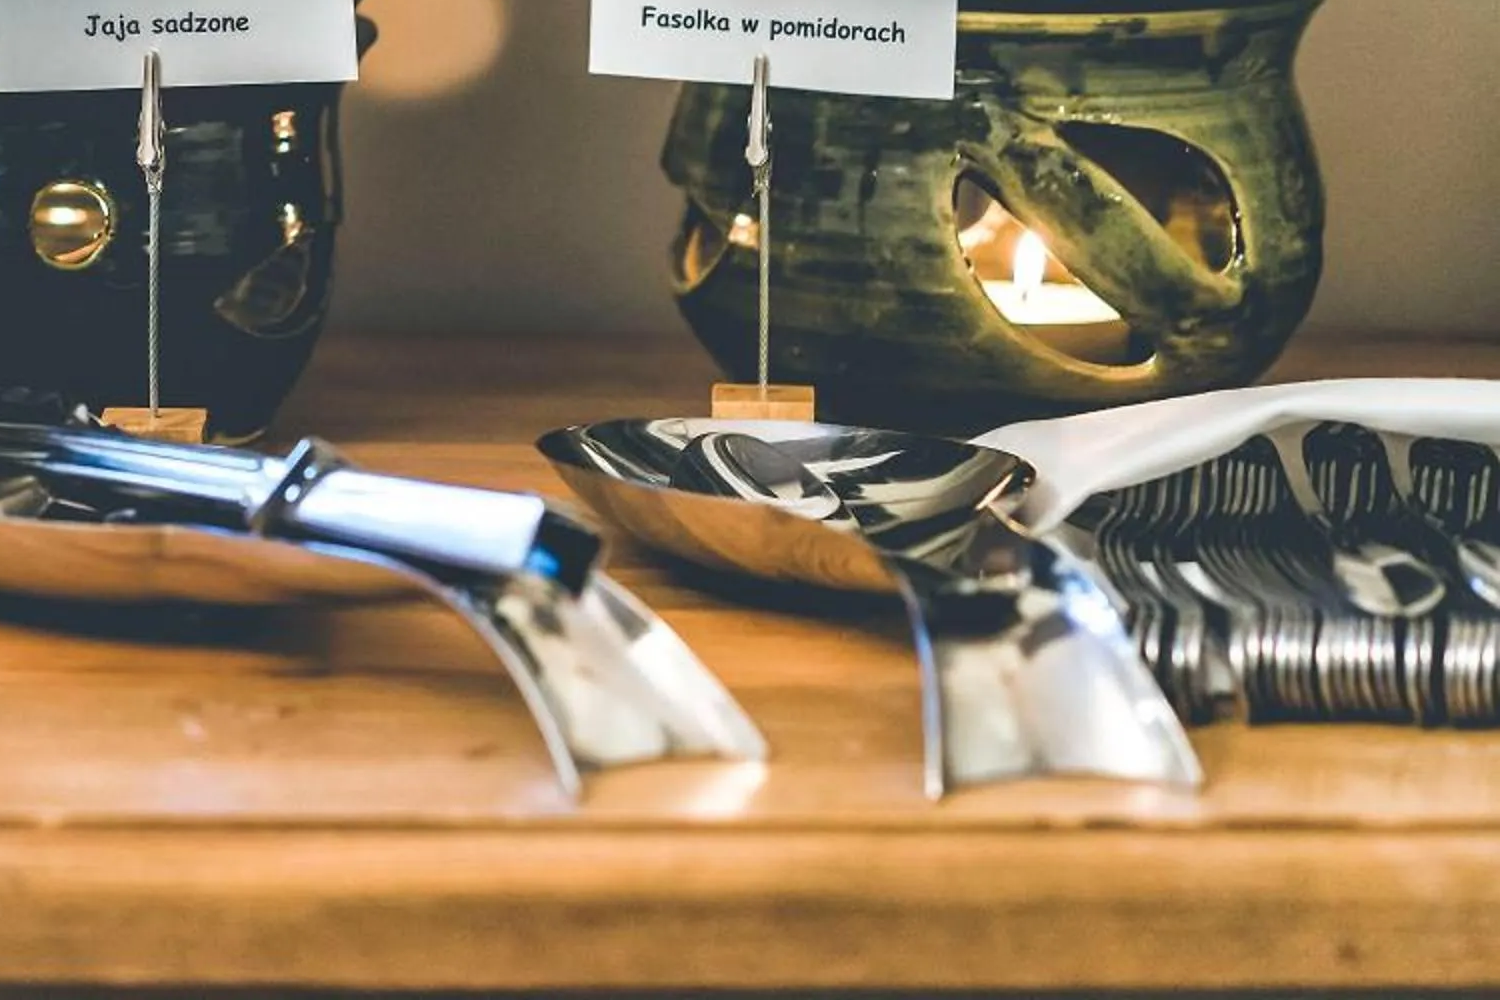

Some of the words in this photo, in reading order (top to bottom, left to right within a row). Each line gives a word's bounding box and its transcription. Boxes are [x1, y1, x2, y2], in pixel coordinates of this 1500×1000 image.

[82, 12, 141, 43] Jaja
[150, 10, 250, 35] sadzone
[640, 5, 731, 32] Fasolka
[740, 18, 759, 33] w
[768, 17, 906, 44] pomidorach
